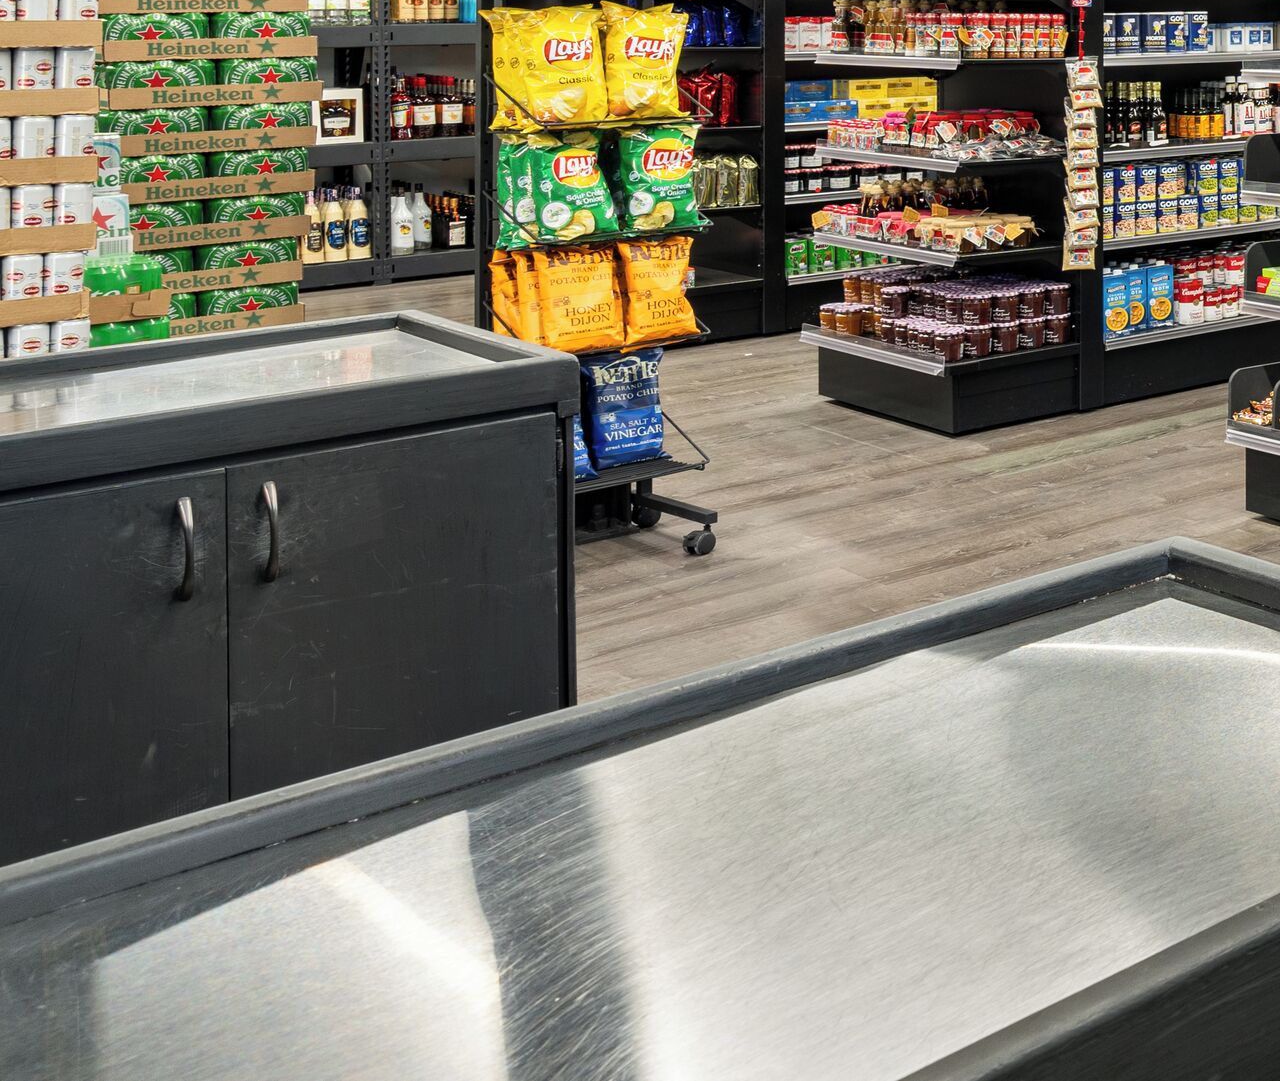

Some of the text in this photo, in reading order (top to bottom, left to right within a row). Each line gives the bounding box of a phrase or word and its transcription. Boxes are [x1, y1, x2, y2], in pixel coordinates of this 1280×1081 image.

[147, 42, 249, 57] Heineken
[558, 76, 594, 85] Classic
[152, 90, 254, 105] Heineken
[144, 135, 247, 153] Heineken
[646, 146, 693, 169] Lay's
[145, 181, 247, 200] Heineken
[666, 188, 687, 196] Onion
[566, 194, 584, 202] Sour
[139, 226, 241, 247] Heineken
[571, 266, 599, 274] BRAND
[632, 271, 668, 280] POTATO
[166, 273, 232, 290] neken
[550, 275, 589, 286] POTATO
[565, 302, 613, 318] HONEY
[652, 306, 685, 320] DIJON
[172, 318, 236, 336] neken
[570, 315, 611, 327] DIJON
[592, 356, 658, 386] KETTLE
[616, 383, 643, 391] BRAND
[598, 392, 634, 403] POTATO
[628, 418, 648, 427] SALT
[605, 424, 663, 441] VINEGAR
